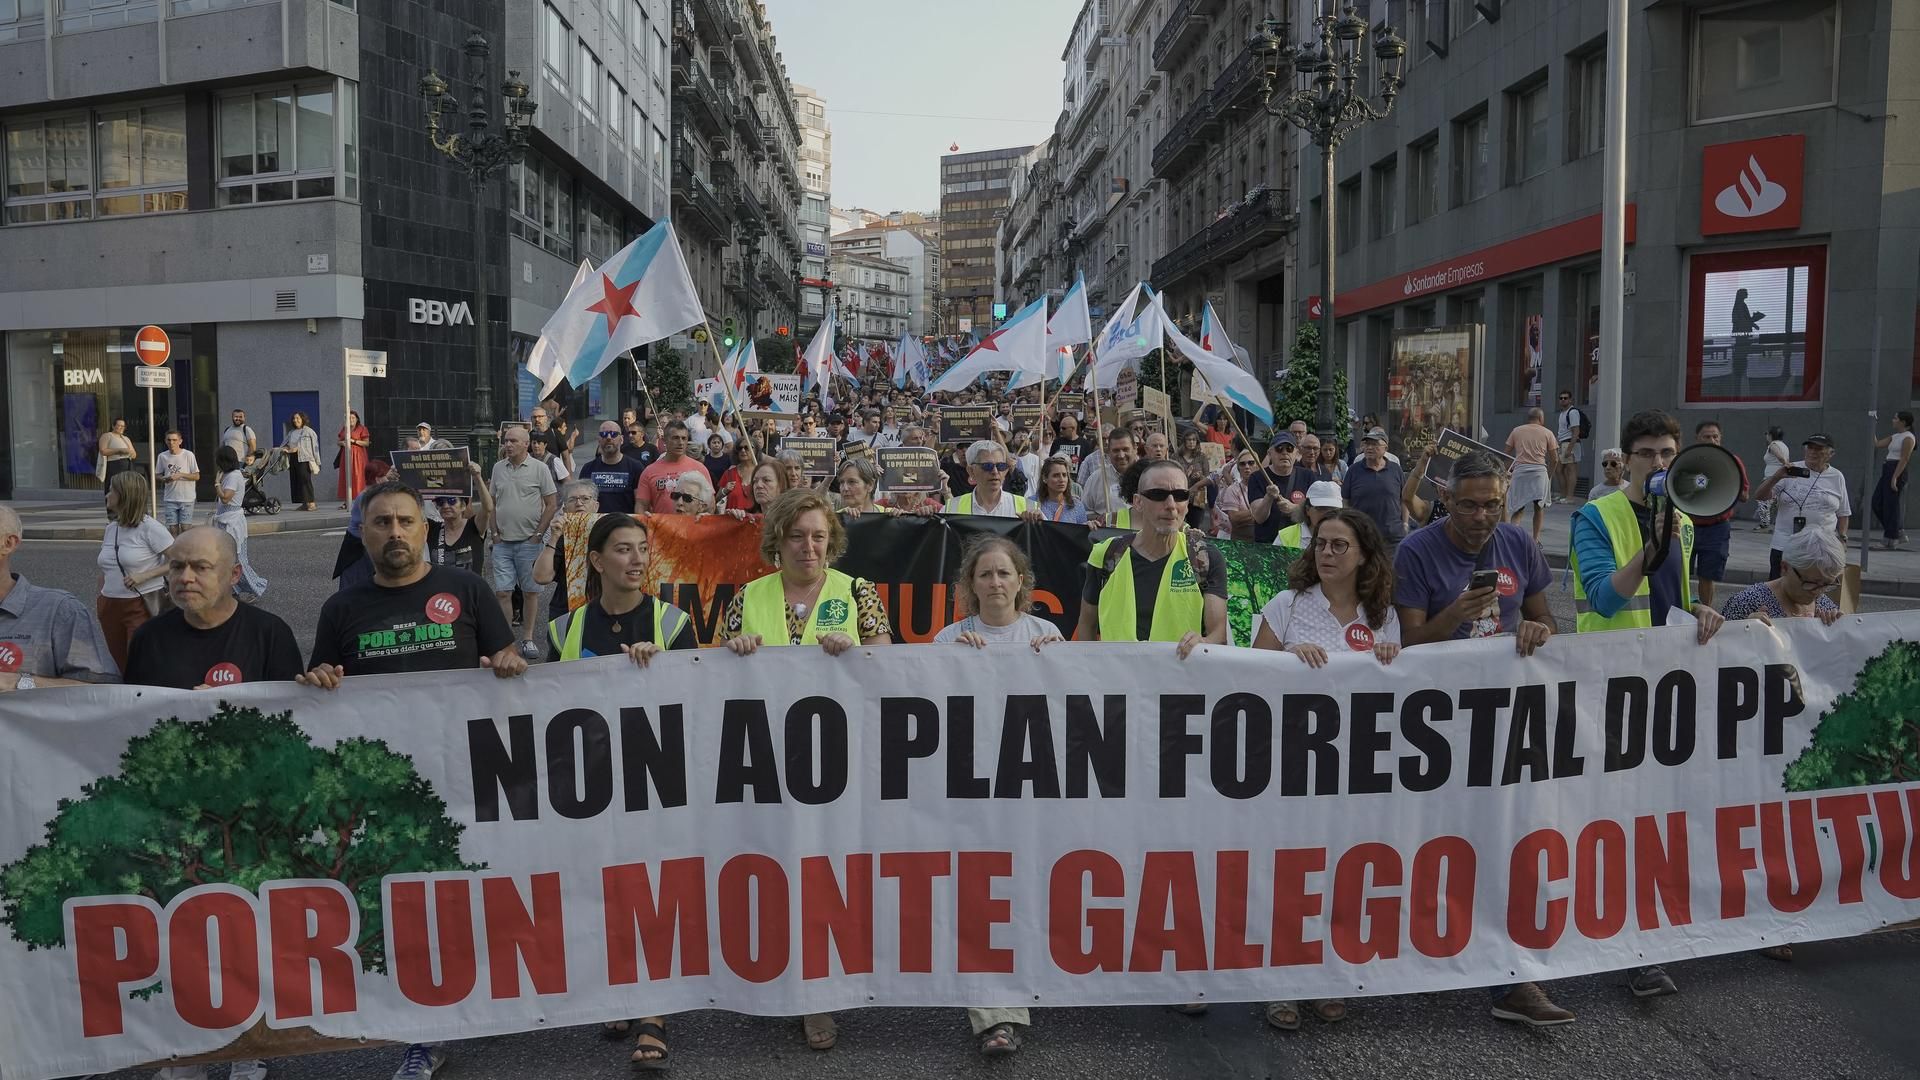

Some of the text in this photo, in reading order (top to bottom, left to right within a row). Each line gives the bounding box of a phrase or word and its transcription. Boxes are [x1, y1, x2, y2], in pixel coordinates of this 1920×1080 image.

[1412, 261, 1484, 292] Santander Empresas
[409, 297, 475, 327] BBVA
[64, 367, 104, 386] BBVA
[773, 383, 798, 392] NUNCA
[778, 392, 798, 403] MÁIS
[785, 441, 833, 449] LUMES FORESTAIS
[1447, 439, 1461, 451] CON
[434, 598, 455, 614] CIG
[358, 631, 396, 650] POR
[1351, 629, 1369, 641] CIG
[365, 649, 385, 657] temos
[385, 647, 399, 655] que
[400, 644, 419, 652] dicir
[420, 642, 434, 651] que
[213, 669, 234, 682] CIG
[467, 664, 1806, 823] NON AO PLAN FORESTAL DO PP
[73, 886, 358, 1039] POR
[390, 872, 568, 1007] UN
[601, 851, 1014, 986] MONTE
[1048, 835, 1477, 975] GALEGO
[1507, 811, 1691, 949] CON
